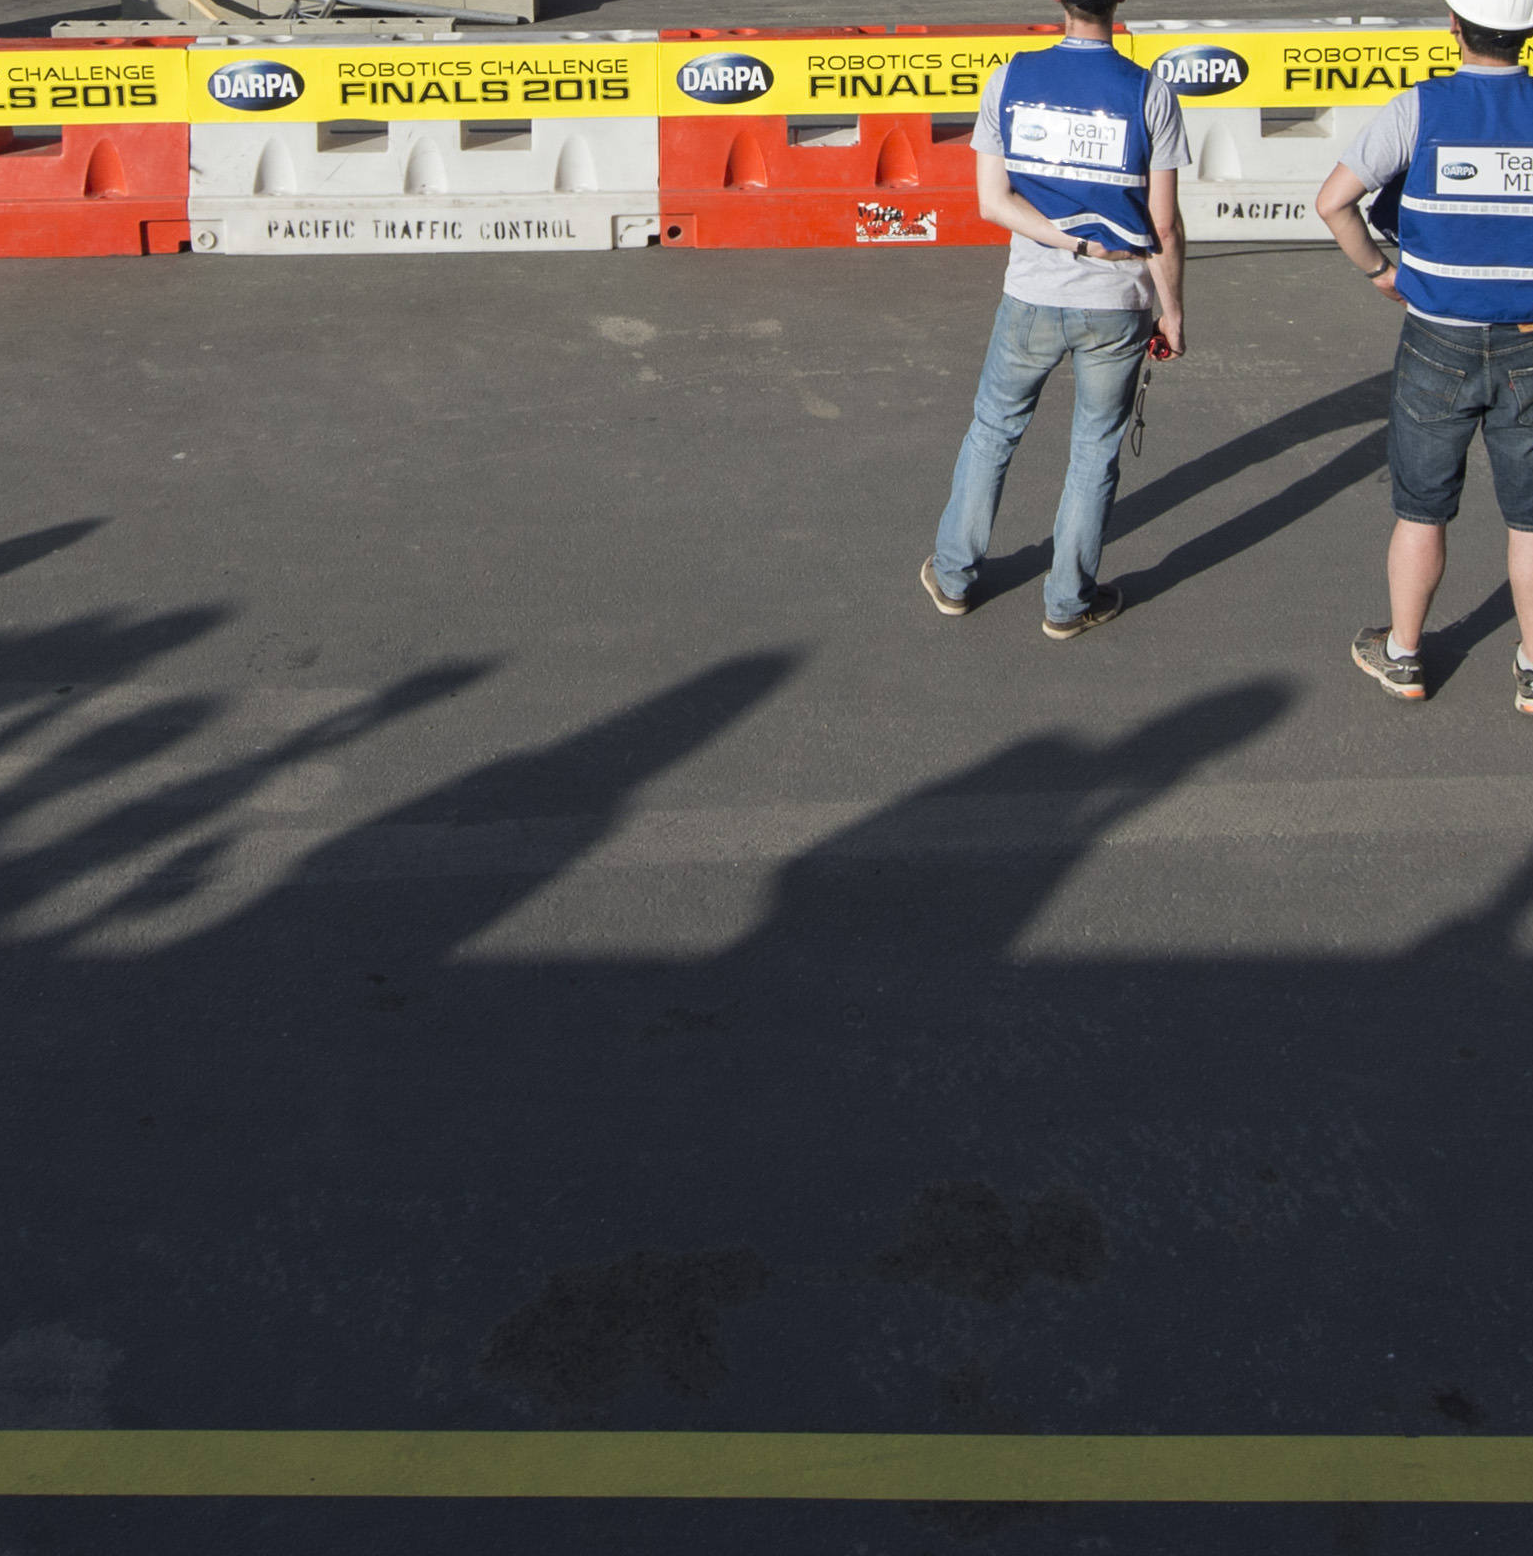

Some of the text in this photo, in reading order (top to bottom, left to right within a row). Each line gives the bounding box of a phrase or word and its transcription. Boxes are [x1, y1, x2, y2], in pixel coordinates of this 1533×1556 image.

[808, 53, 942, 71] ROBOTICS
[1284, 46, 1418, 63] ROBOTICS
[8, 65, 155, 82] CHALLENGE
[338, 59, 628, 78] ROBOTICS CHALLENGE
[683, 66, 767, 91] DARPA
[1157, 58, 1242, 83] DARPA
[214, 73, 298, 99] DARPA
[340, 78, 630, 105] FINALS 2015
[809, 73, 979, 97] FINALS
[51, 84, 158, 108] 2015
[1064, 117, 1116, 141] Team
[1069, 139, 1109, 160] MIT
[1442, 164, 1476, 177] DARPA
[1217, 202, 1306, 220] PACIFIC
[268, 219, 576, 240] PACIFIC TRAFFIC CONTROL
